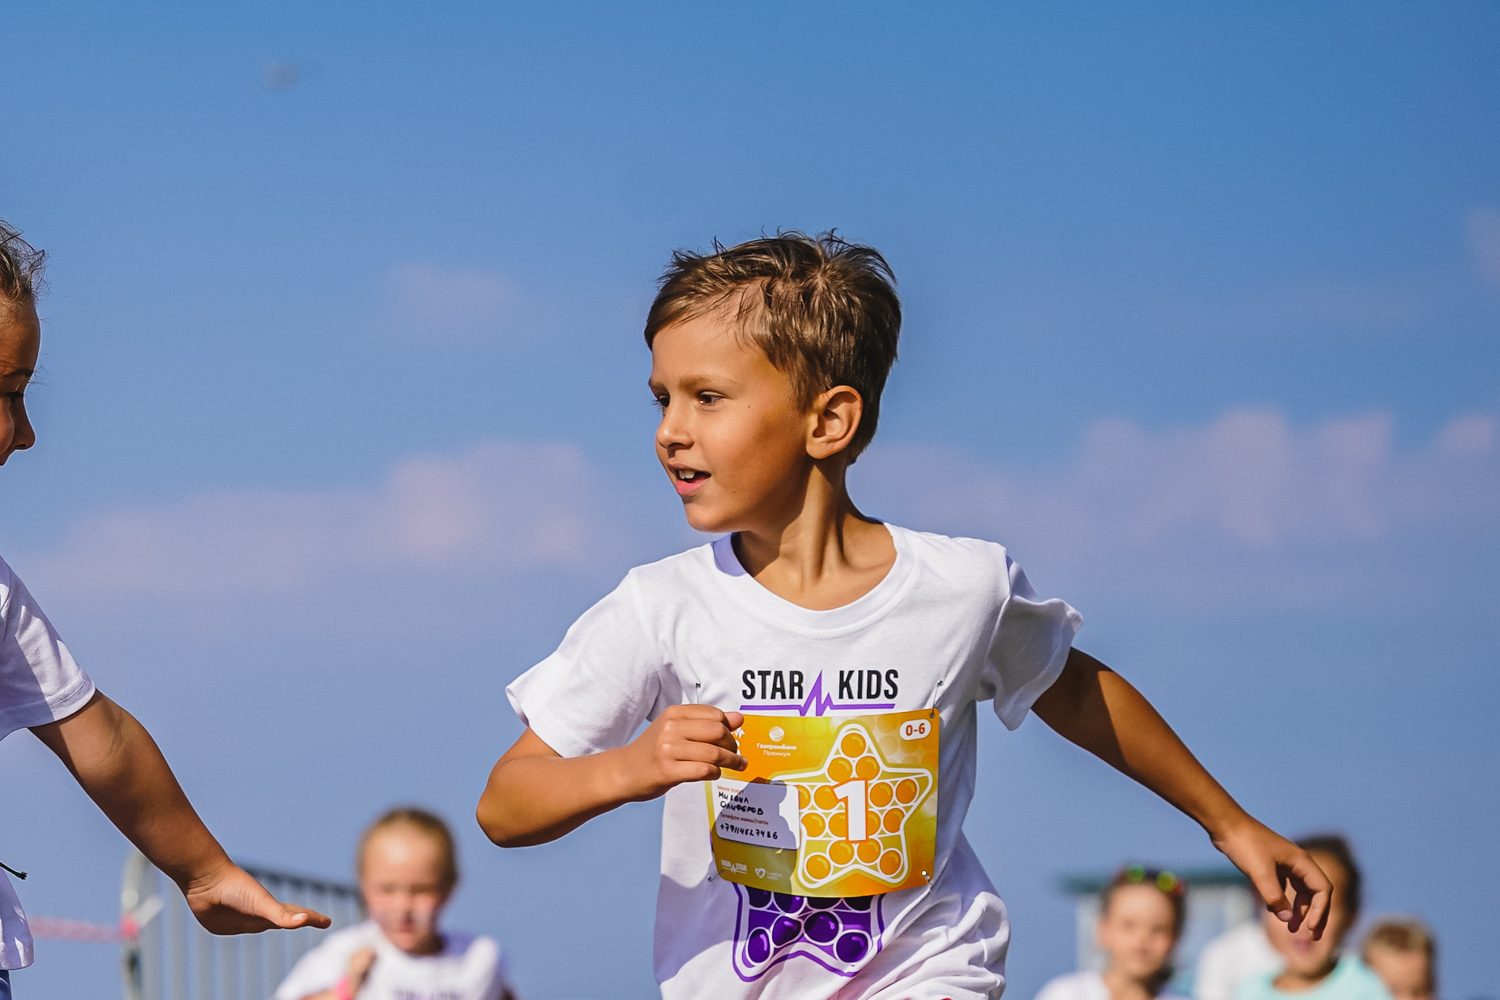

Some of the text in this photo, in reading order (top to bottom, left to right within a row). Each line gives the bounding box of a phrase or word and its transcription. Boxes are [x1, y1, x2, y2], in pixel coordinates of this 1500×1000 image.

[741, 669, 899, 700] STAR KIDS
[905, 722, 926, 737] 0-6
[832, 779, 867, 842] 1
